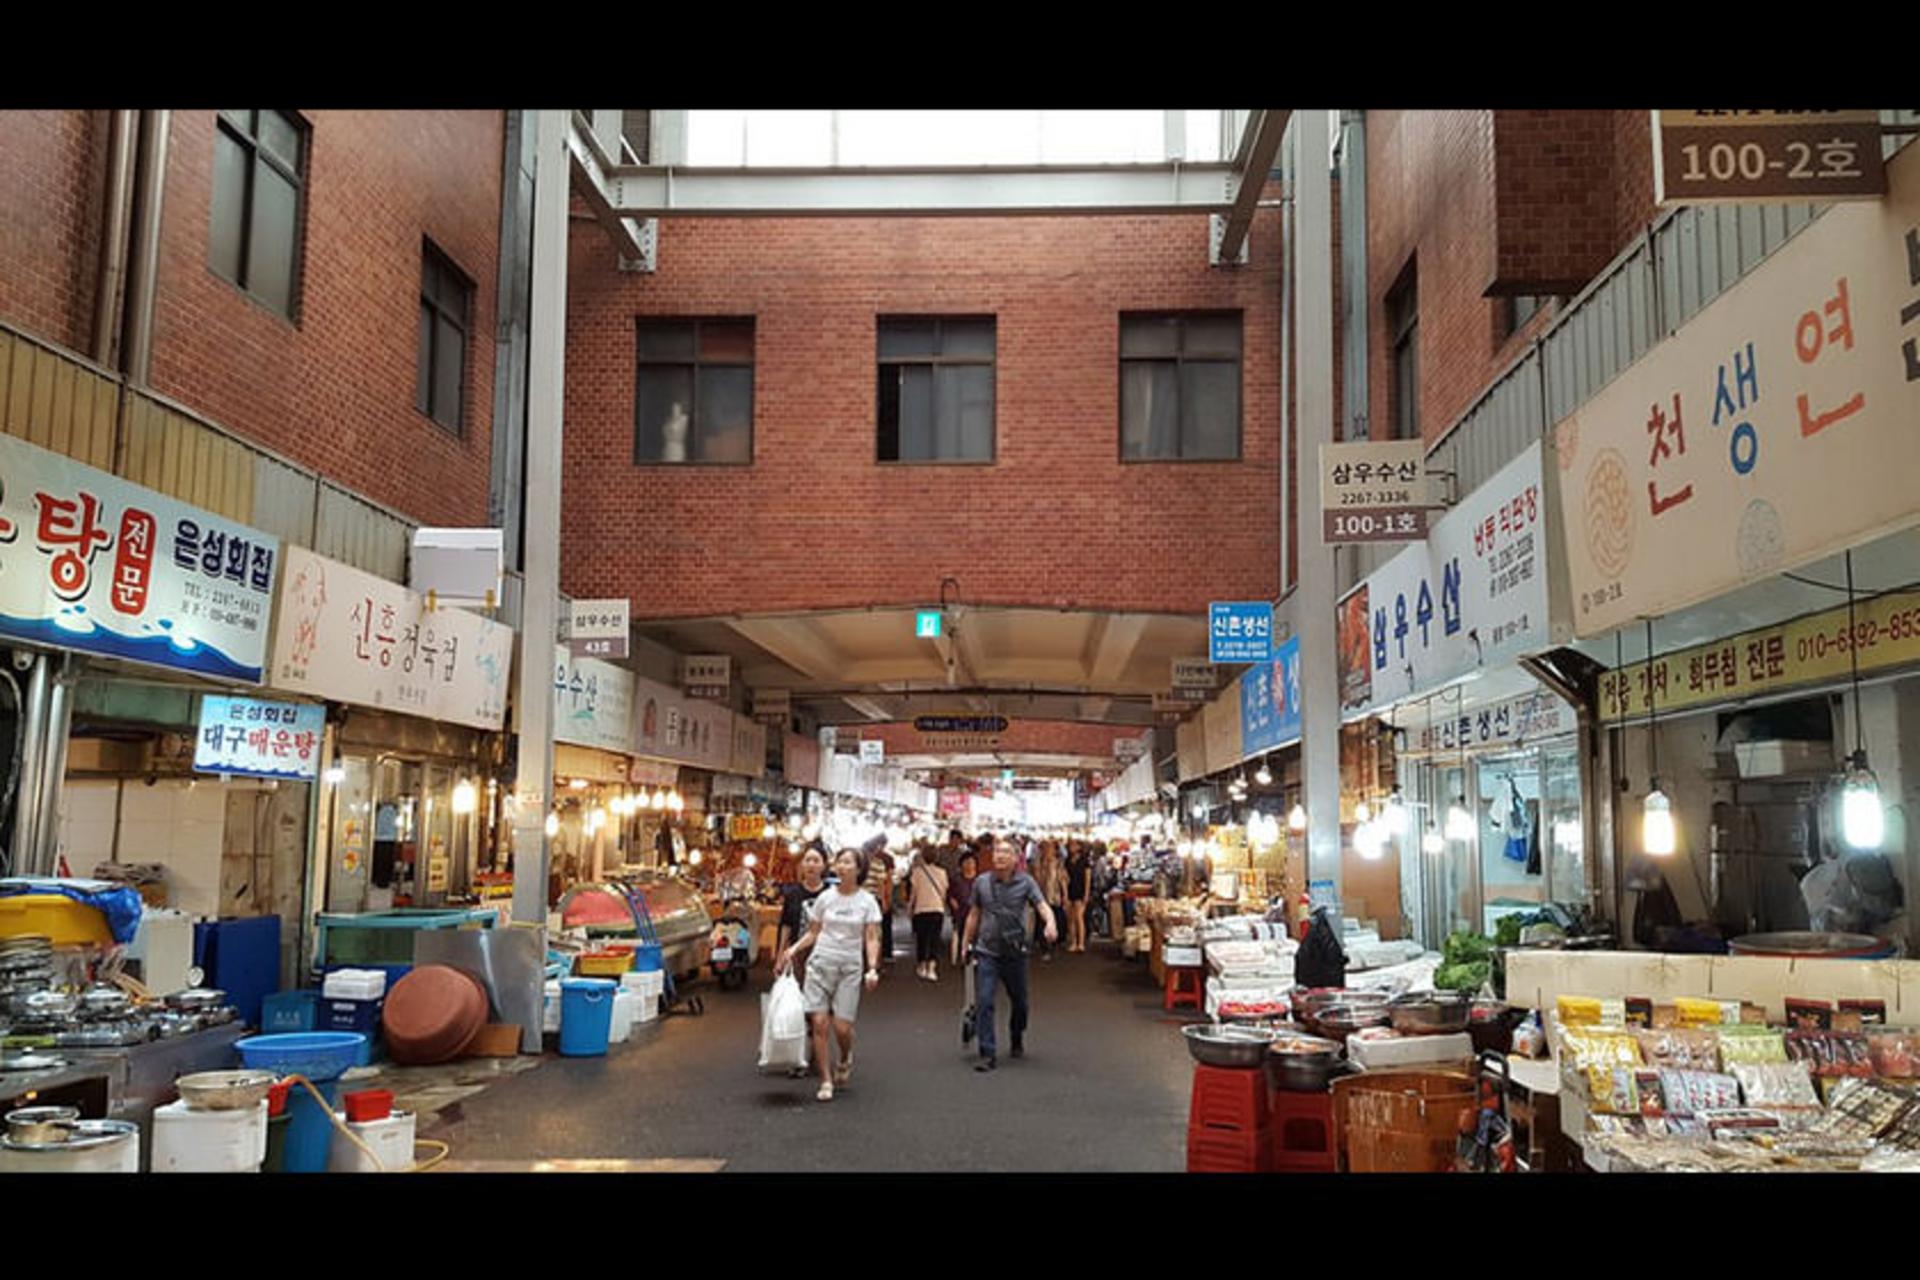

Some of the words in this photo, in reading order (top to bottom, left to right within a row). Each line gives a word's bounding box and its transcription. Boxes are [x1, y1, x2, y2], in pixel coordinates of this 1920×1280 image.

[1680, 138, 1863, 182] 100-2호
[1332, 461, 1418, 485] 삼우수산
[1341, 491, 1409, 505] 2267-3336
[1334, 512, 1418, 535] 100-1호
[113, 518, 150, 608] 전문
[174, 518, 274, 594] 은성회집
[1215, 616, 1269, 638] 신촌생선
[1373, 556, 1461, 671] 삼우수산
[1688, 645, 1738, 695] 회무침
[1747, 634, 1786, 684] 전문
